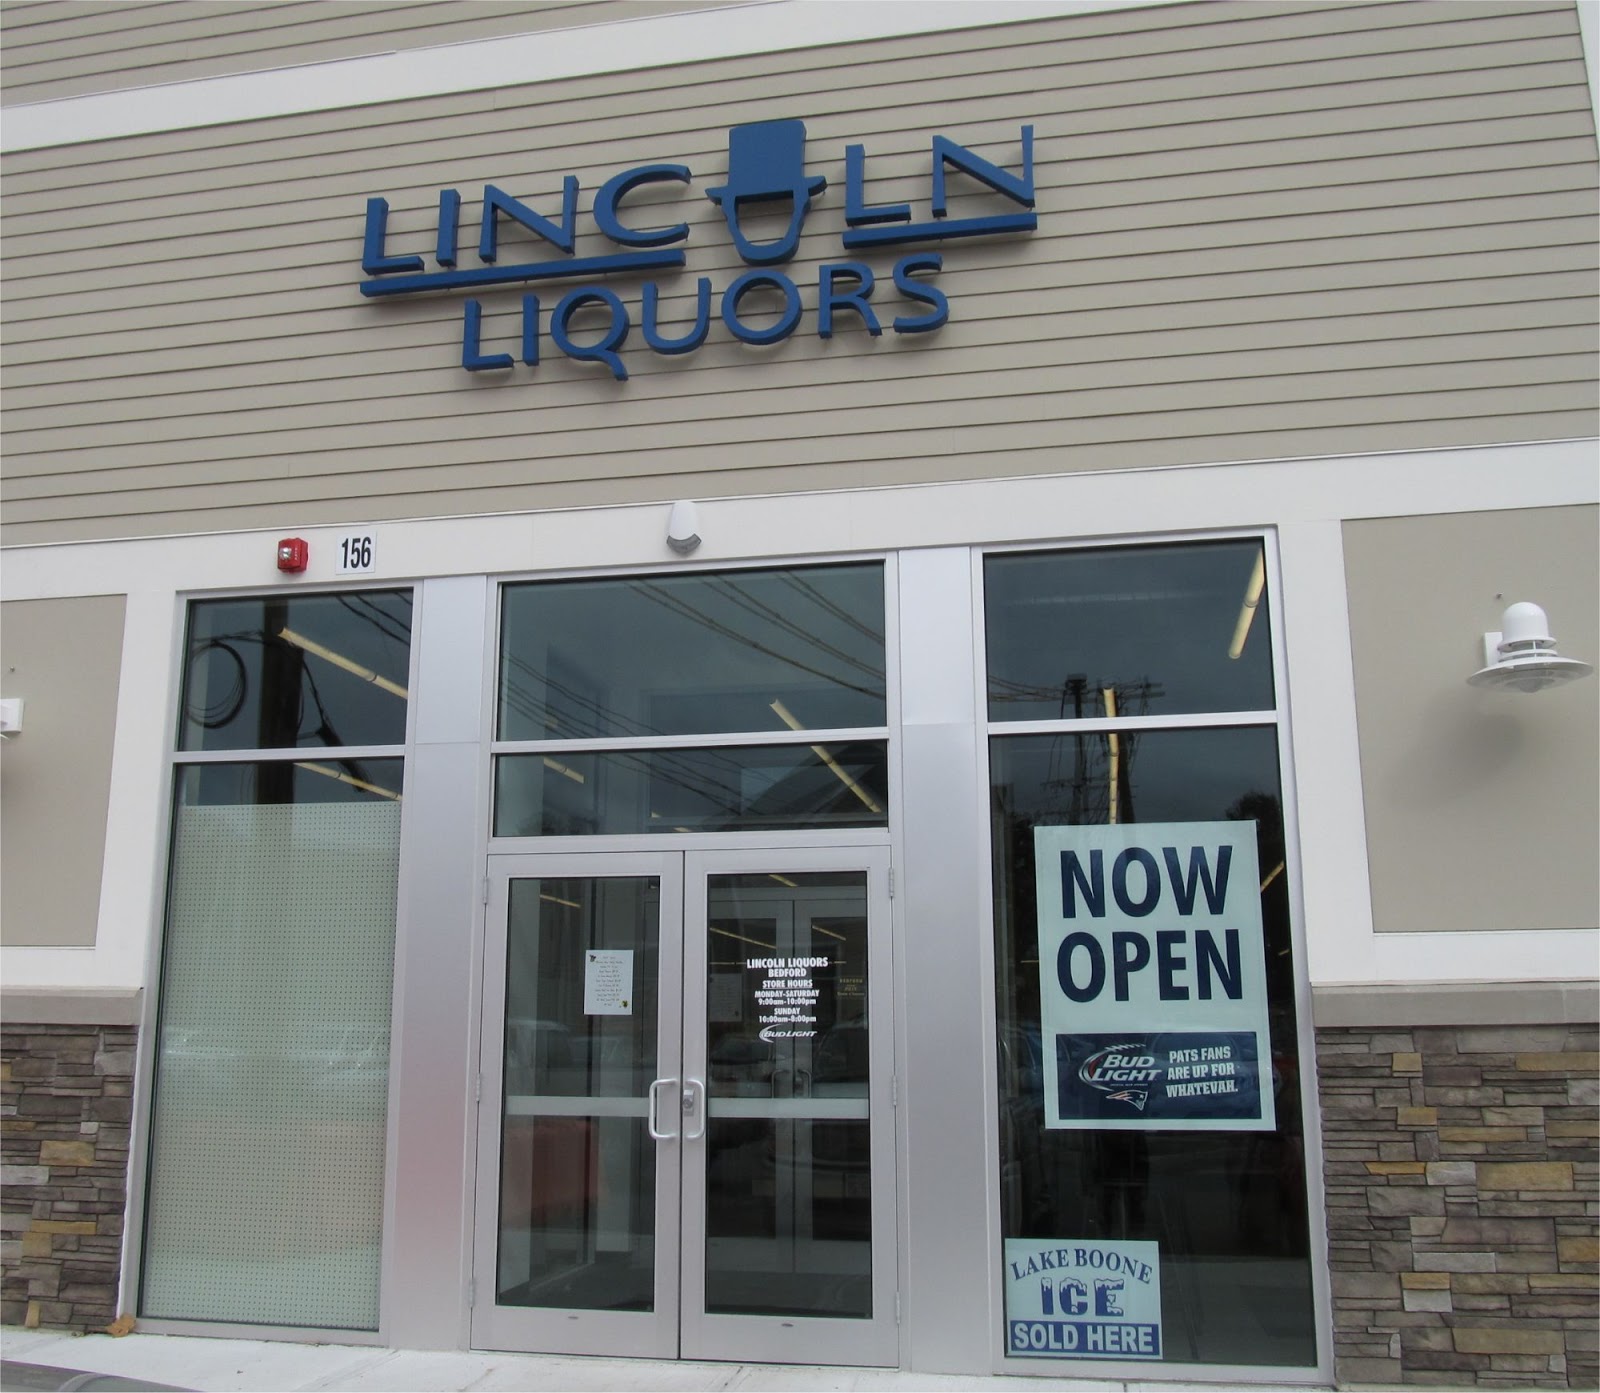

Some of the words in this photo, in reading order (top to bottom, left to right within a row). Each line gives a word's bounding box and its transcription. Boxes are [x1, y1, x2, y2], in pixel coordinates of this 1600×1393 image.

[462, 253, 950, 381] LIQUORS
[341, 536, 371, 569] 156
[1060, 845, 1233, 919] NOW
[746, 958, 785, 969] LINCOLN
[787, 956, 829, 968] LIQUORS
[1056, 928, 1243, 1003] OPEN
[768, 968, 807, 978] BEDFORD
[762, 980, 786, 989] STORE
[787, 979, 813, 988] HOURS
[754, 989, 820, 998] MONDAY-SATURDAY
[758, 998, 817, 1006] 9:00am-10:00pm
[758, 1015, 817, 1024] 10:00am-8:00pm
[773, 1007, 801, 1016] SUNDAY
[1103, 1054, 1155, 1068] BUD
[1169, 1048, 1198, 1064] PATS
[1201, 1046, 1231, 1060] FANS
[1091, 1069, 1162, 1081] LIGHT
[1167, 1066, 1191, 1080] ARE
[1192, 1064, 1210, 1078] UP
[1211, 1062, 1235, 1076] FOR
[1165, 1080, 1239, 1098] WHATEVAH.
[1010, 1248, 1069, 1281] LAKE
[1074, 1248, 1153, 1285] BOONE
[1040, 1276, 1125, 1317] ICE
[1013, 1322, 1079, 1350] SOLD
[1086, 1325, 1154, 1352] HERE
